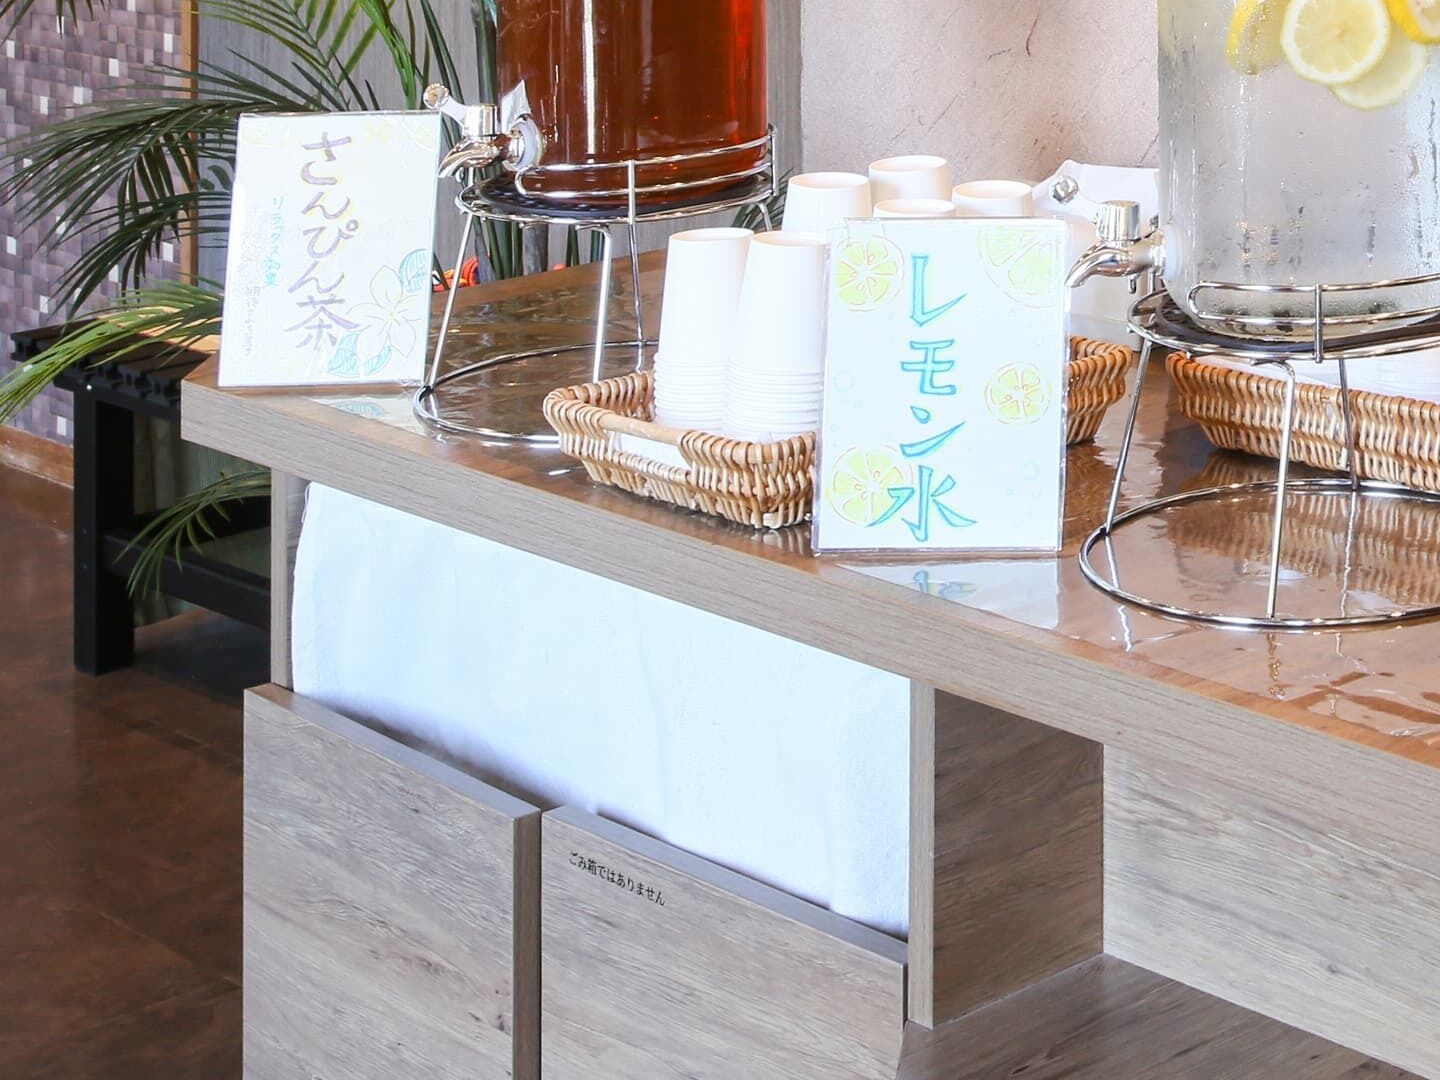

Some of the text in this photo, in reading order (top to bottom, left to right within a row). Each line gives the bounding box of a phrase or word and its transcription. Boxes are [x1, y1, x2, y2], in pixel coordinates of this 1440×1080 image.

[285, 131, 374, 349] さんぴん茶
[866, 254, 977, 542] レモン水
